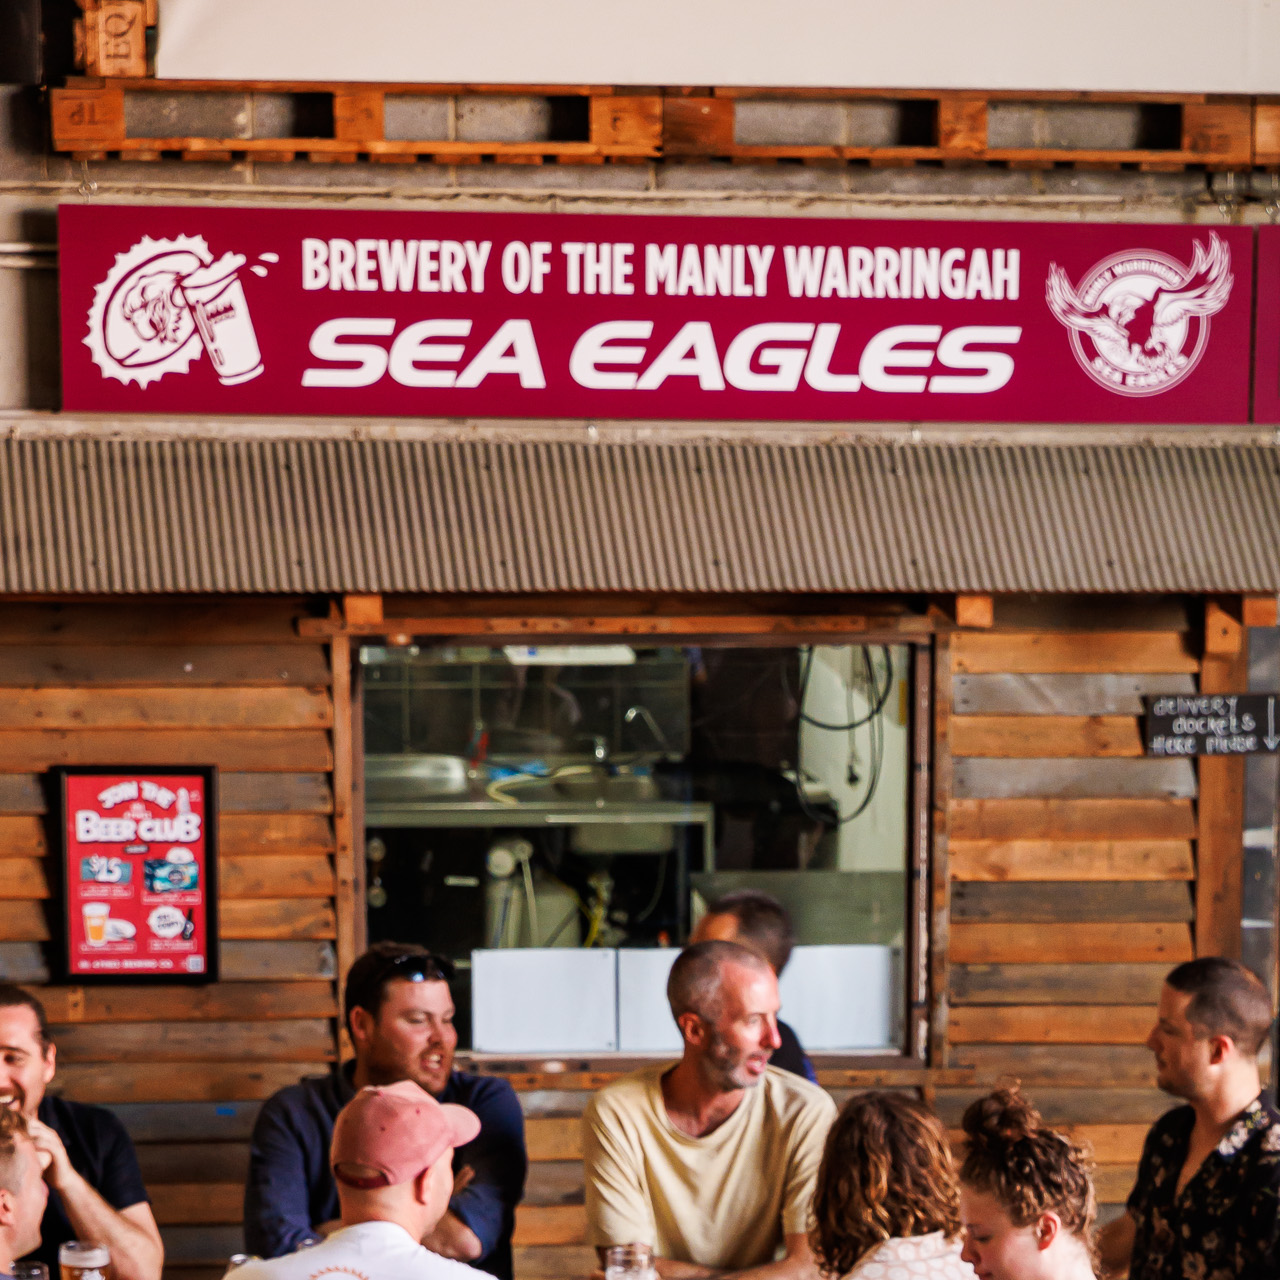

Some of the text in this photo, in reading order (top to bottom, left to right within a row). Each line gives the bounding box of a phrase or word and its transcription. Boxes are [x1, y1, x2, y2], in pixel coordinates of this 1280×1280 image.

[301, 238, 1021, 300] BREWERY OF THE MANLY WARRINGAH
[301, 318, 1023, 394] SEA EAGLES
